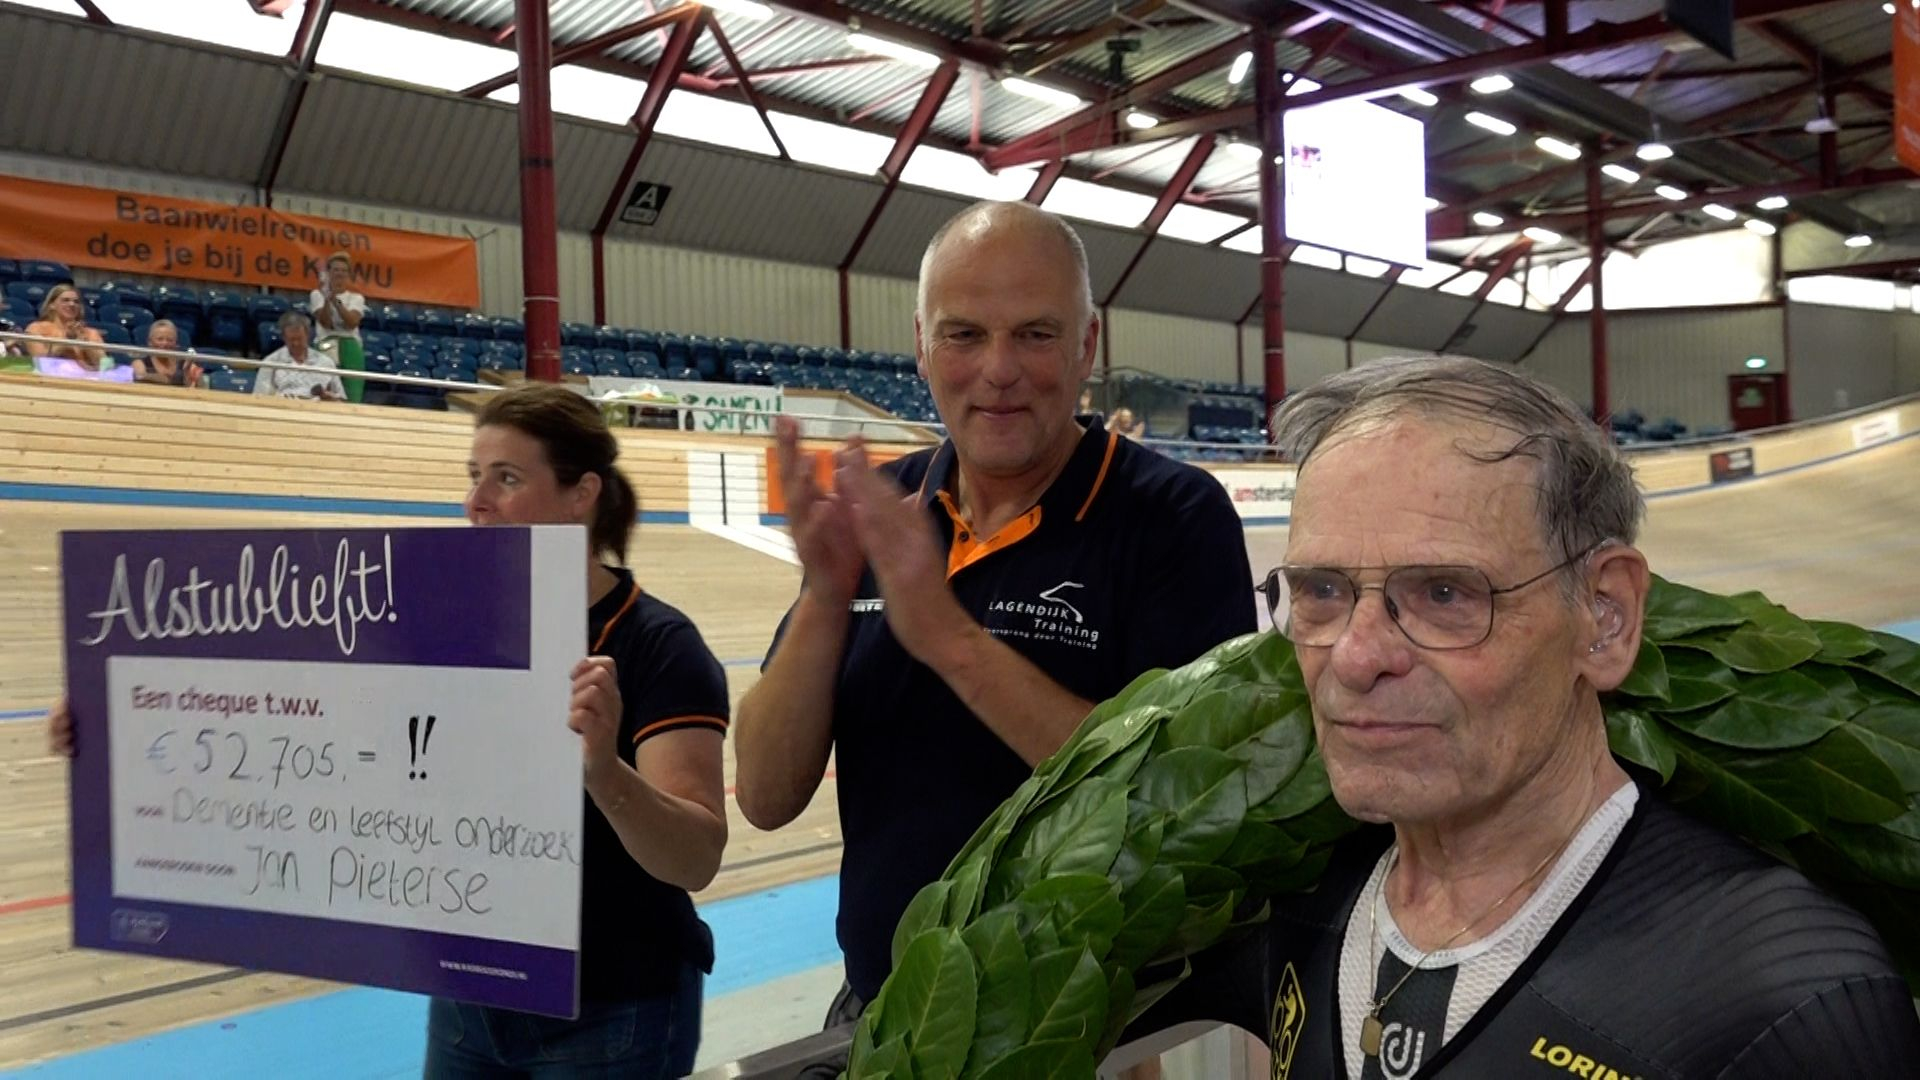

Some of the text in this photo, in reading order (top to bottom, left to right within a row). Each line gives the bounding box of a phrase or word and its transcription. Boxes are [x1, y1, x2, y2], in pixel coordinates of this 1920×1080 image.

[634, 185, 658, 208] A
[116, 195, 371, 251] Baanwielrennen
[87, 232, 393, 289] doe je bij de KWU
[78, 533, 399, 656] Alstublieft!
[989, 600, 1069, 619] LAGENDIJK
[1034, 617, 1099, 642] Training
[131, 685, 324, 719] Een cheque t.w.v.
[172, 787, 297, 832] Dementie
[308, 806, 338, 833] en
[327, 846, 493, 914] Pieterse
